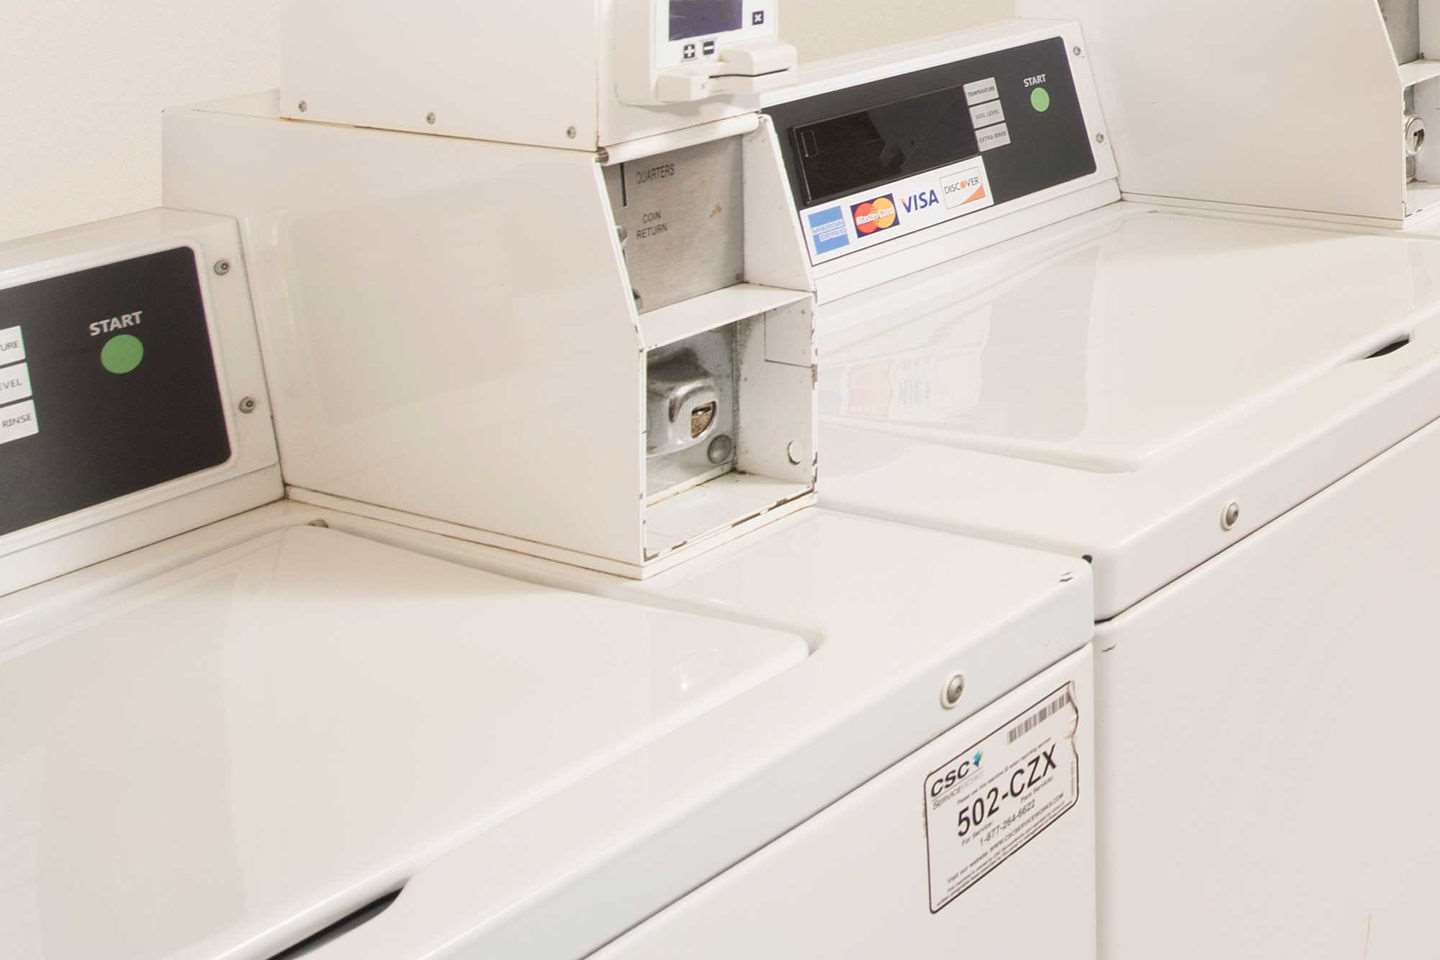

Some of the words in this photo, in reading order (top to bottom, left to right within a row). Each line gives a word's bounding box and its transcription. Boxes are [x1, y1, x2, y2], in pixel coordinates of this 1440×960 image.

[1023, 74, 1046, 87] START
[944, 176, 979, 194] DISCOVER
[901, 189, 939, 213] VISA
[89, 311, 143, 336] START
[2, 413, 31, 428] RINSE
[931, 761, 970, 797] CSC
[957, 743, 1057, 837] 502-CZX
